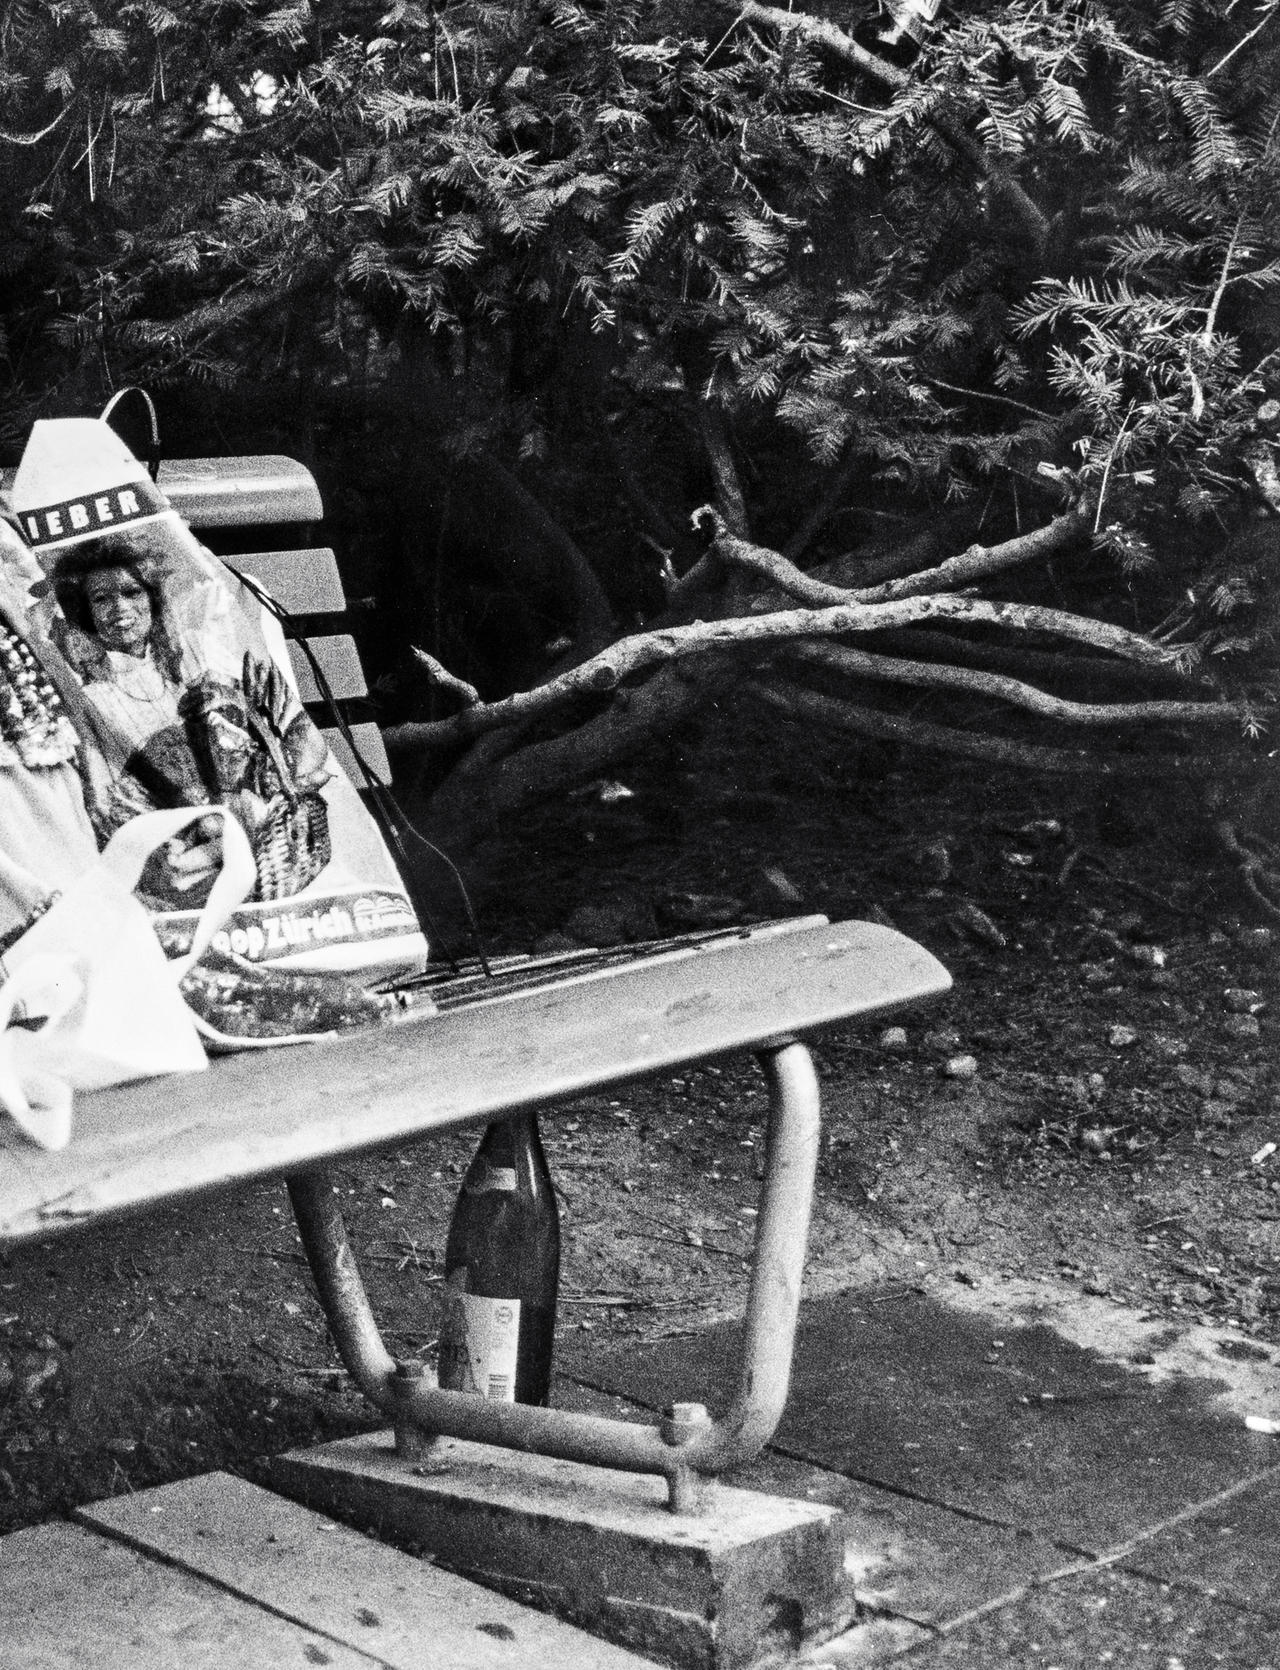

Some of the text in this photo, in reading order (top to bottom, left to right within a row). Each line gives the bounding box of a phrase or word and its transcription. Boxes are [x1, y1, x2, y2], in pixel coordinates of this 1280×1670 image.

[26, 490, 141, 540] IEBER
[211, 925, 266, 959] oop
[262, 905, 355, 950] Zürich
